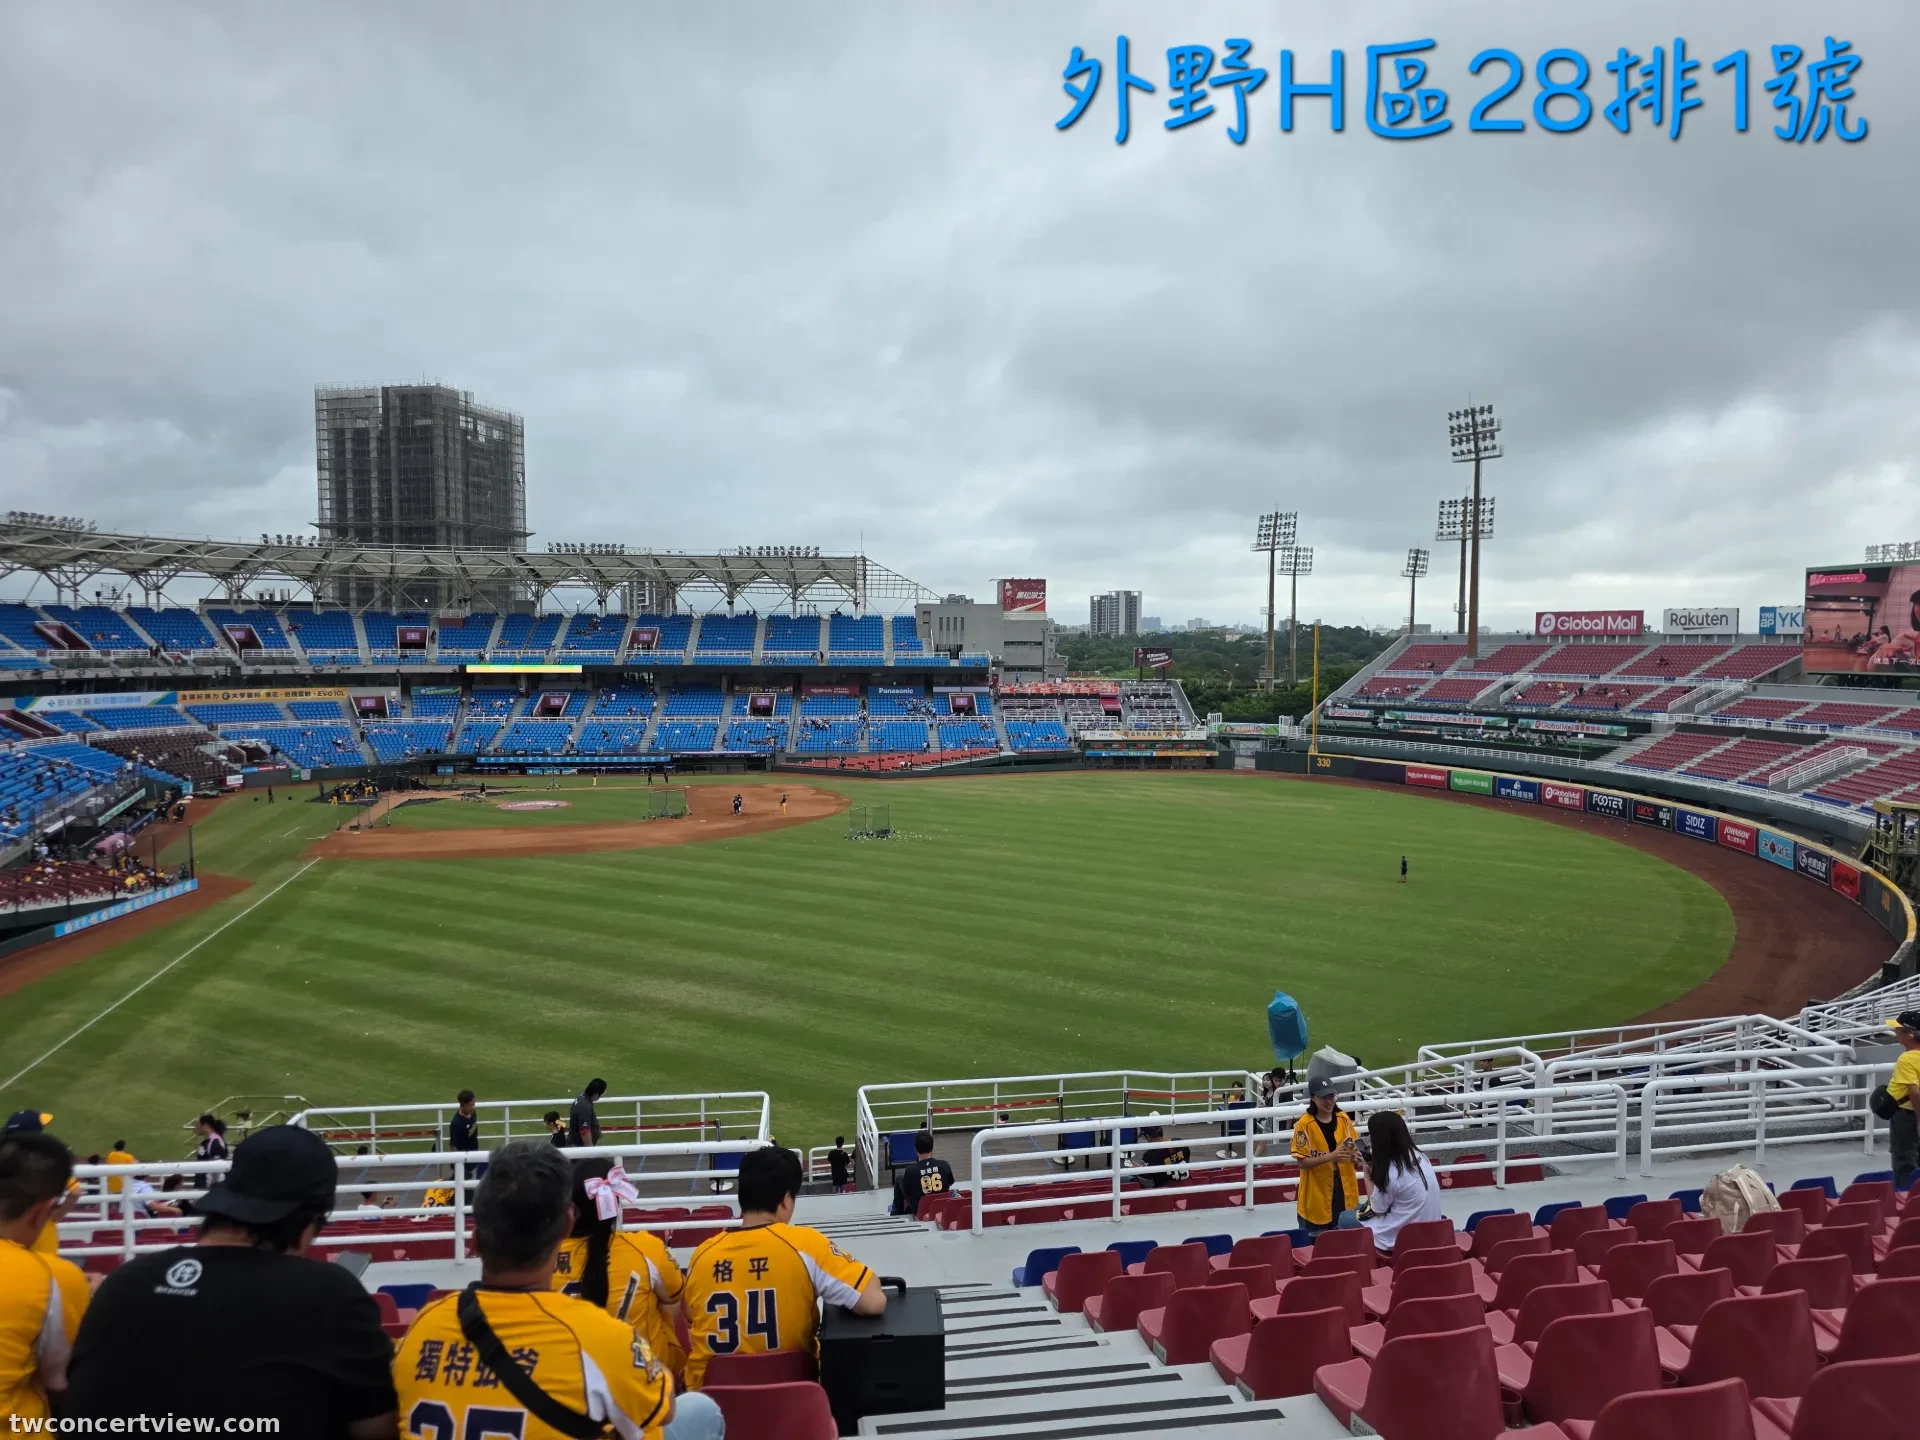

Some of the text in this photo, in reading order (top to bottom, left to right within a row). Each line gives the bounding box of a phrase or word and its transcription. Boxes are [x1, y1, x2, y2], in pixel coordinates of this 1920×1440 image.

[1557, 615, 1637, 630] Global Mall
[1670, 612, 1728, 627] Rakuten
[1760, 619, 1775, 628] ap
[879, 687, 914, 695] Panasonic
[1316, 757, 1331, 768] 330
[1685, 814, 1706, 830] SIDIZ
[1723, 825, 1751, 840] JOHNSON
[705, 1288, 780, 1354] 34
